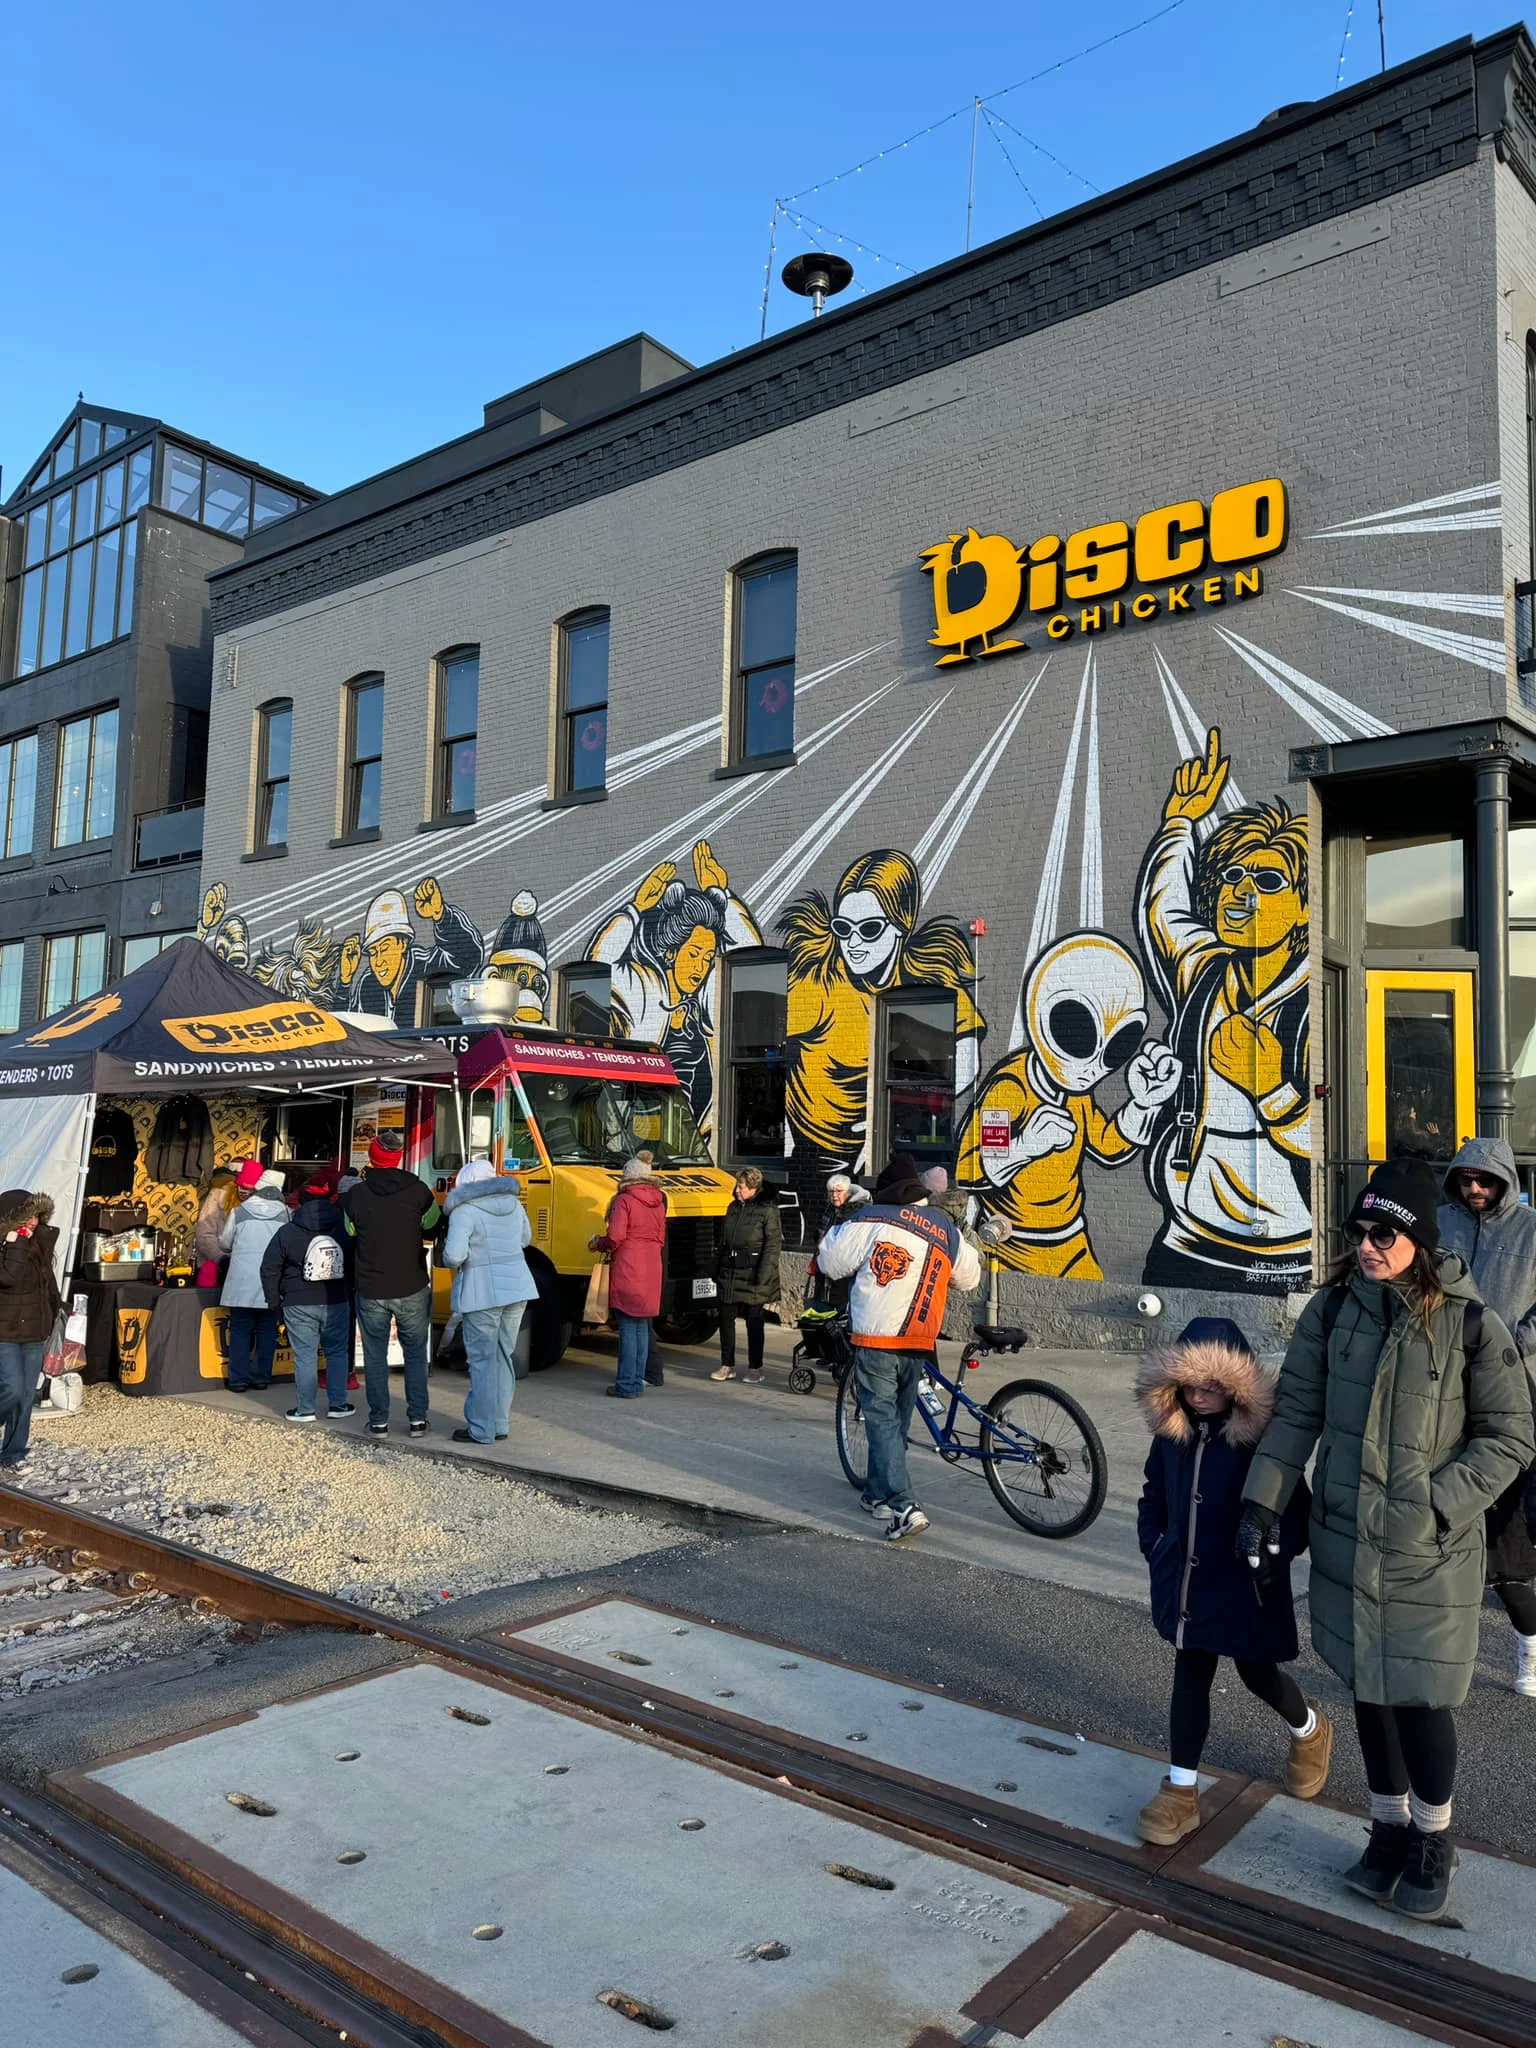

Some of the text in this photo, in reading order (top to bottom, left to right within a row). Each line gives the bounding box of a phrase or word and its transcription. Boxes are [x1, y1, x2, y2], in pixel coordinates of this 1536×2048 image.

[1047, 567, 1263, 640] CHICKEN
[250, 1026, 325, 1045] CHICKEN
[421, 1035, 469, 1053] TS
[514, 1043, 665, 1068] SANDWICHES TENDERS TOTS
[0, 1063, 74, 1084] ENDERS TOTS
[134, 1061, 275, 1076] SANDWICHES
[1375, 1196, 1417, 1223] MIDWEST
[899, 1208, 949, 1245] CHICAG
[917, 1257, 943, 1323] BEARS
